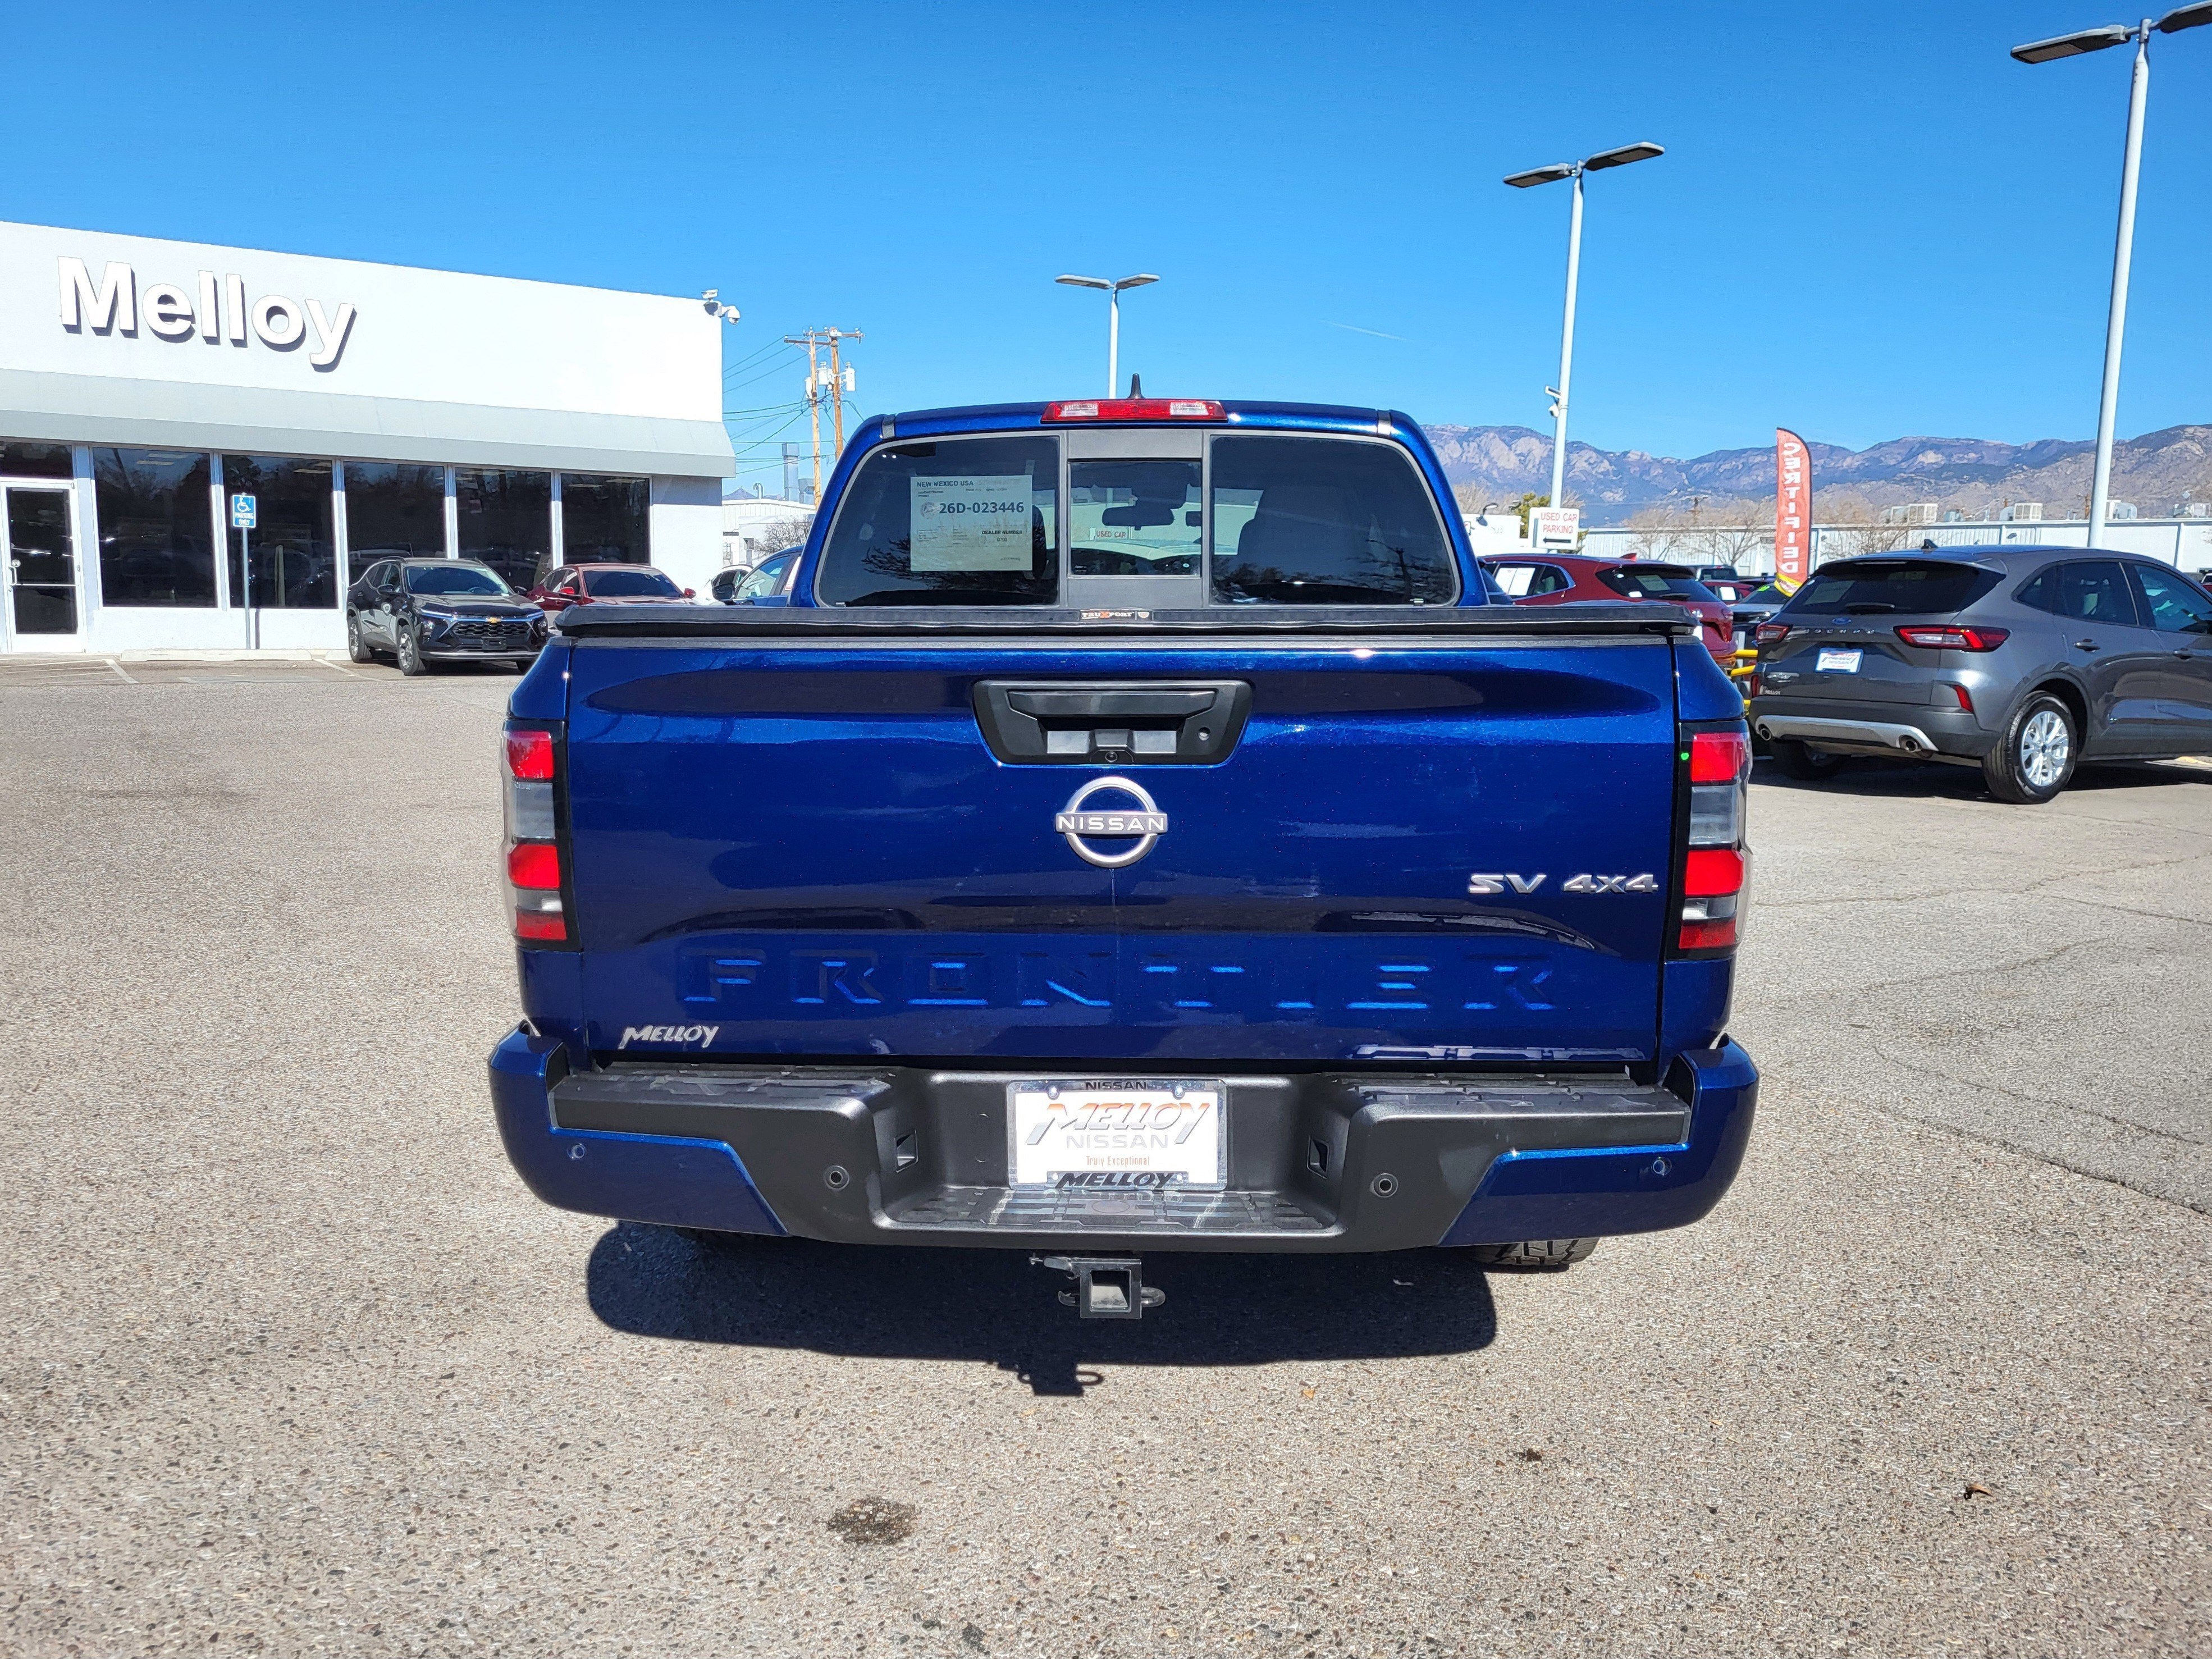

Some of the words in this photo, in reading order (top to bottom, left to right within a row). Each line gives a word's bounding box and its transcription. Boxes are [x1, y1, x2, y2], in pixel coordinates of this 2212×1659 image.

[57, 255, 356, 368] Melloy
[939, 501, 1025, 514] 26D-023446
[1541, 512, 1560, 521] USED
[1563, 513, 1578, 522] CAR
[1543, 524, 1573, 534] PARKING
[1058, 816, 1164, 831] NISSAN
[1469, 874, 1547, 894] SV
[678, 948, 1556, 1011] FRONTIER
[618, 1025, 720, 1050] MELLOY
[1085, 1081, 1148, 1090] NISSAN
[1025, 1103, 1210, 1145] MELLOY
[1066, 1135, 1168, 1149] NISSAN
[1086, 1156, 1104, 1167] Truly
[1108, 1155, 1149, 1167] Exceptional
[1055, 1172, 1175, 1190] MELLOY
